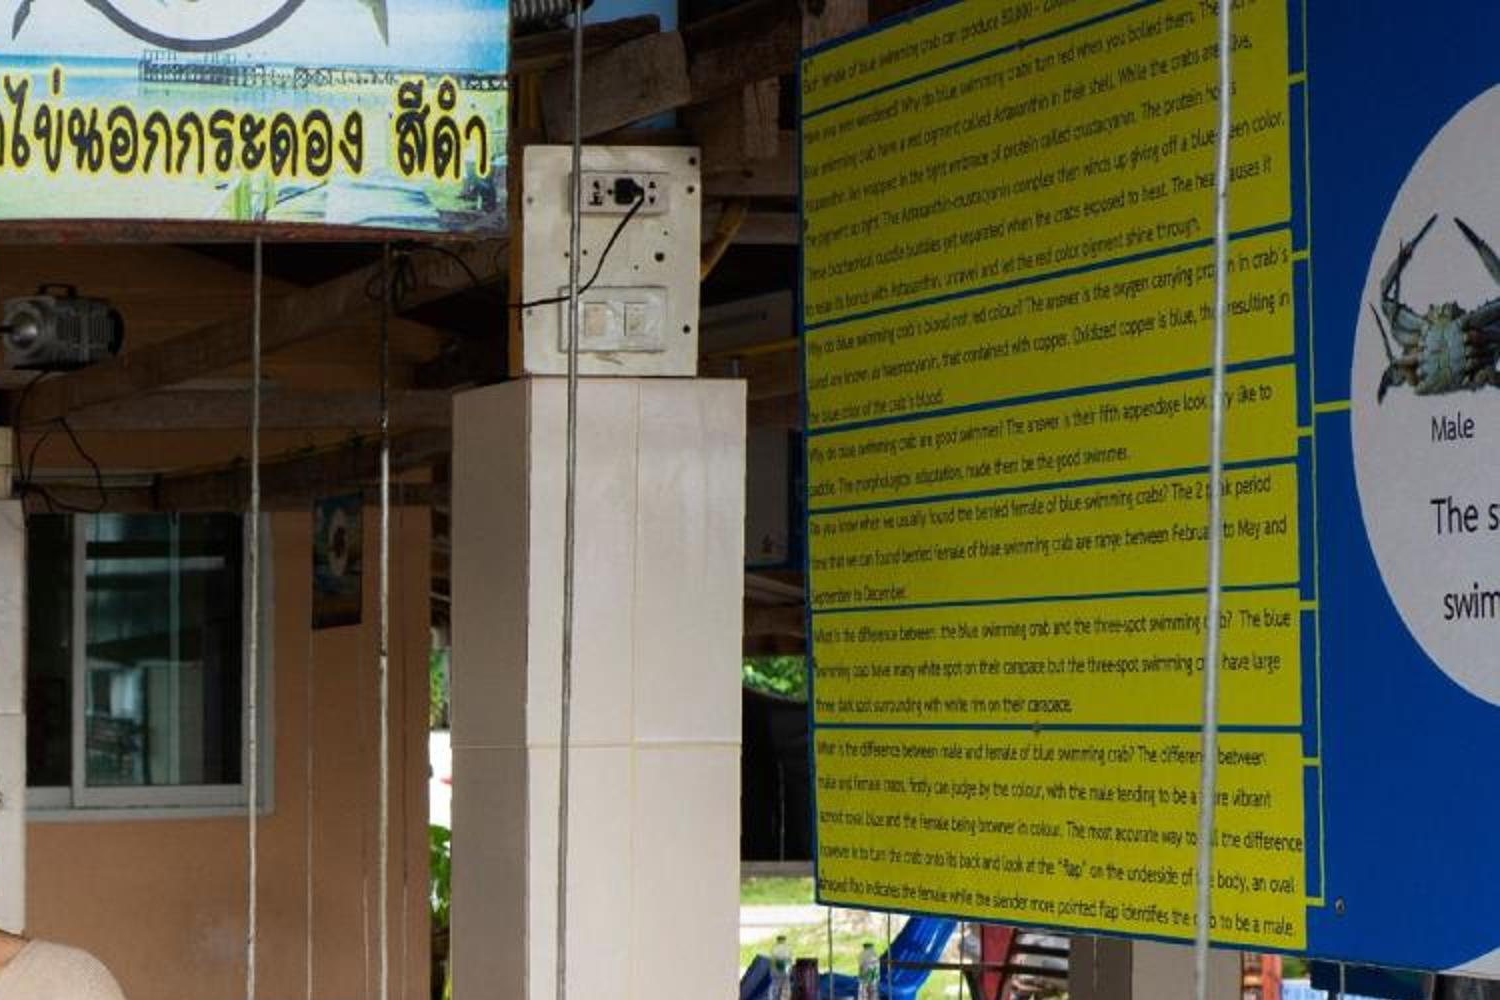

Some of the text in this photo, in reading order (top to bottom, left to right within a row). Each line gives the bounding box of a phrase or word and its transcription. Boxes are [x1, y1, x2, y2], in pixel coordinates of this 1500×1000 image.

[396, 80, 488, 180] สีดำ
[1431, 412, 1476, 443] Male
[1430, 496, 1479, 535] The
